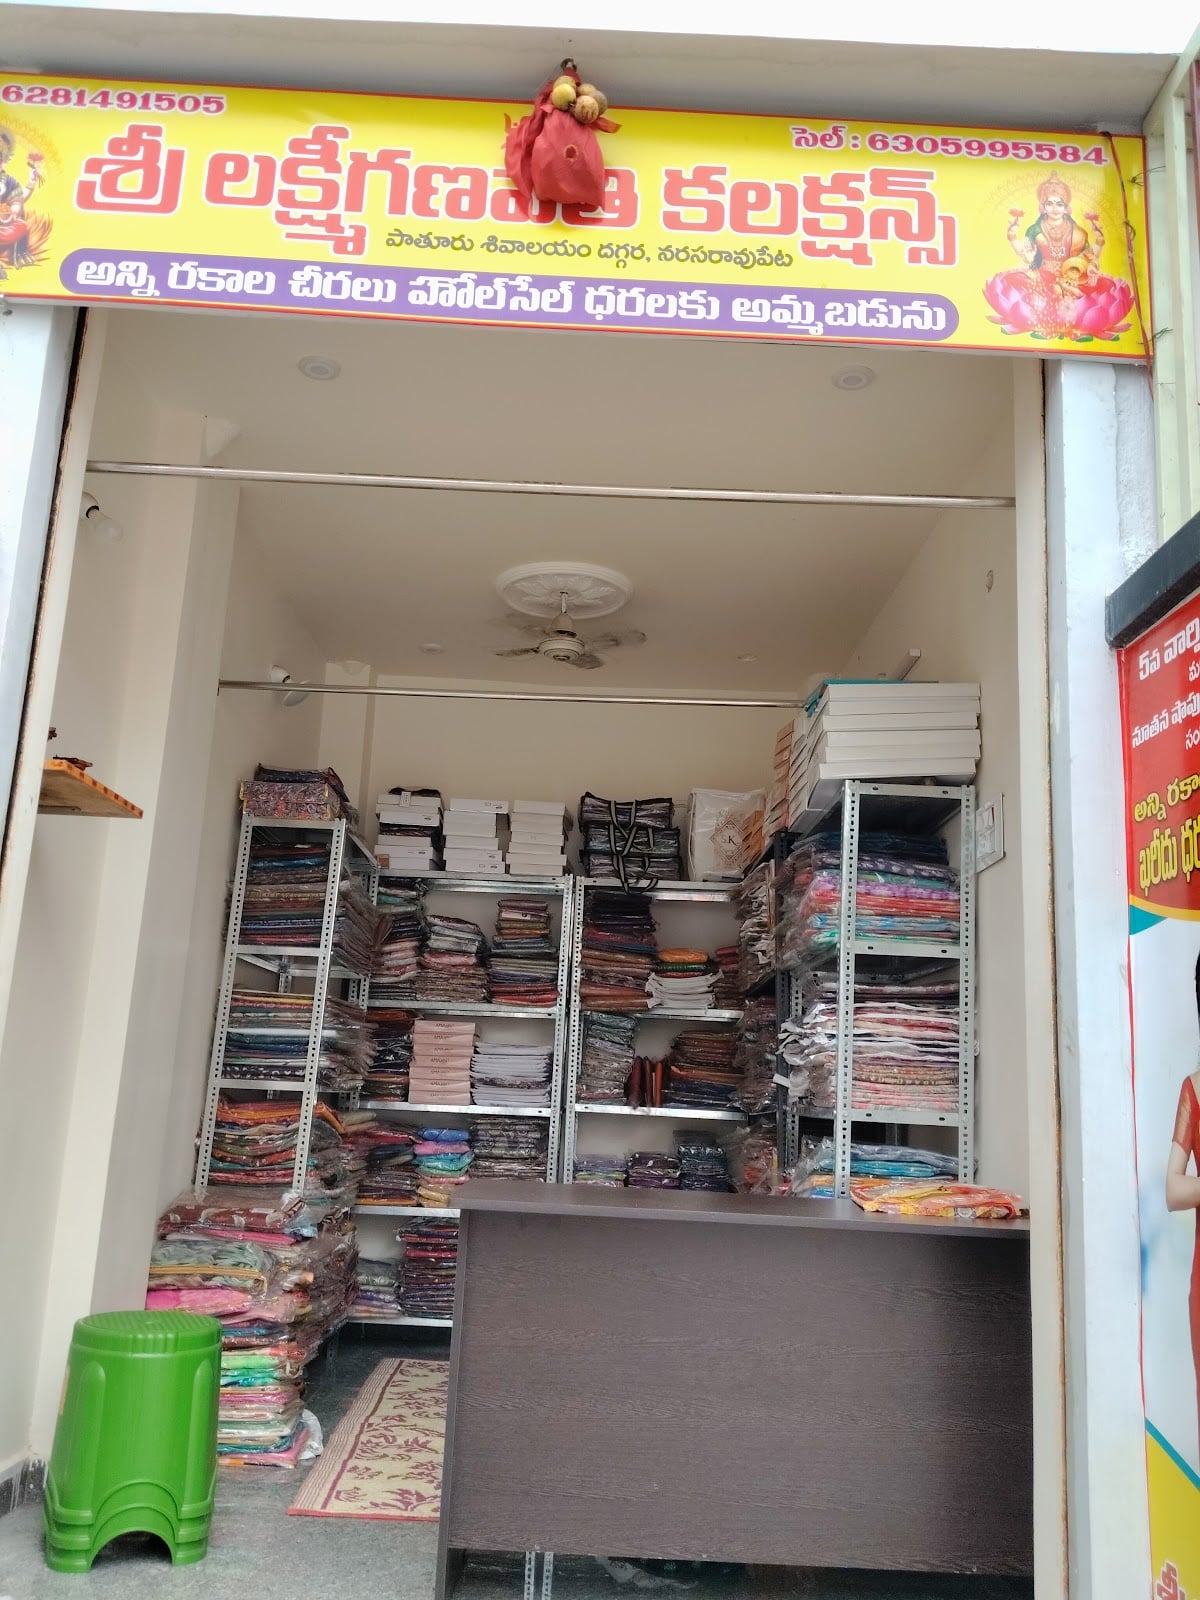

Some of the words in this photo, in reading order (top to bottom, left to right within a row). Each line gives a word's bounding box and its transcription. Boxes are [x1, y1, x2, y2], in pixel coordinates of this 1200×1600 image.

[1, 85, 225, 114] 6281491505
[867, 133, 1108, 166] 6305995584
[76, 124, 186, 214] శ్రీ
[385, 228, 474, 251] పాతూరు
[480, 235, 592, 258] శివాలయం
[657, 244, 794, 270] నరసరావుపేట
[76, 261, 160, 297] అన్ని
[167, 261, 276, 294] రకాల
[288, 265, 397, 303] చీరలు
[584, 285, 720, 321] ధరలకు
[1134, 792, 1167, 822] అన్ని
